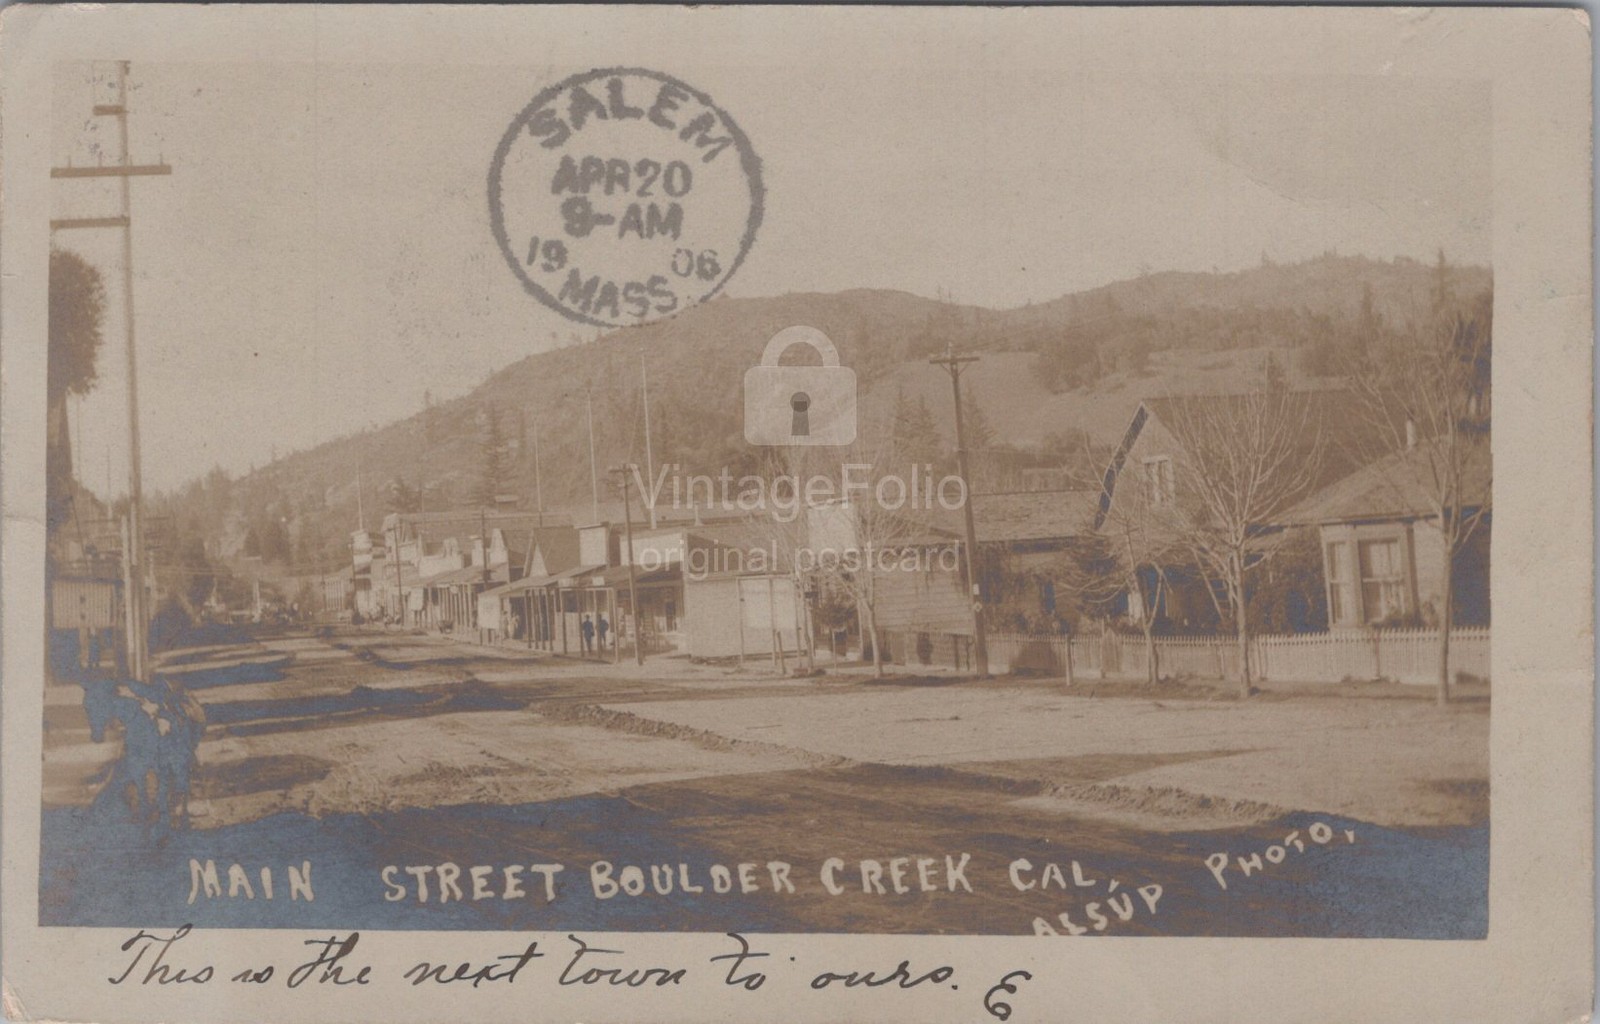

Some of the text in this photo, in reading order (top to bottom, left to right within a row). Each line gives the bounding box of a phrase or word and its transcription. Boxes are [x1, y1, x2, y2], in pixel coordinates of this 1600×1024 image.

[528, 77, 733, 163] SALEM
[526, 235, 569, 273] 19
[671, 247, 722, 281] 06
[558, 267, 678, 318] MASS
[187, 858, 315, 904] MAIN
[381, 862, 564, 904] STREET
[590, 860, 797, 899] BOULDER
[820, 853, 973, 896] CREEK
[108, 923, 214, 985] This
[231, 966, 275, 984] is
[287, 932, 372, 988] the
[403, 942, 544, 988] next
[557, 933, 687, 986] town
[710, 933, 770, 990] to
